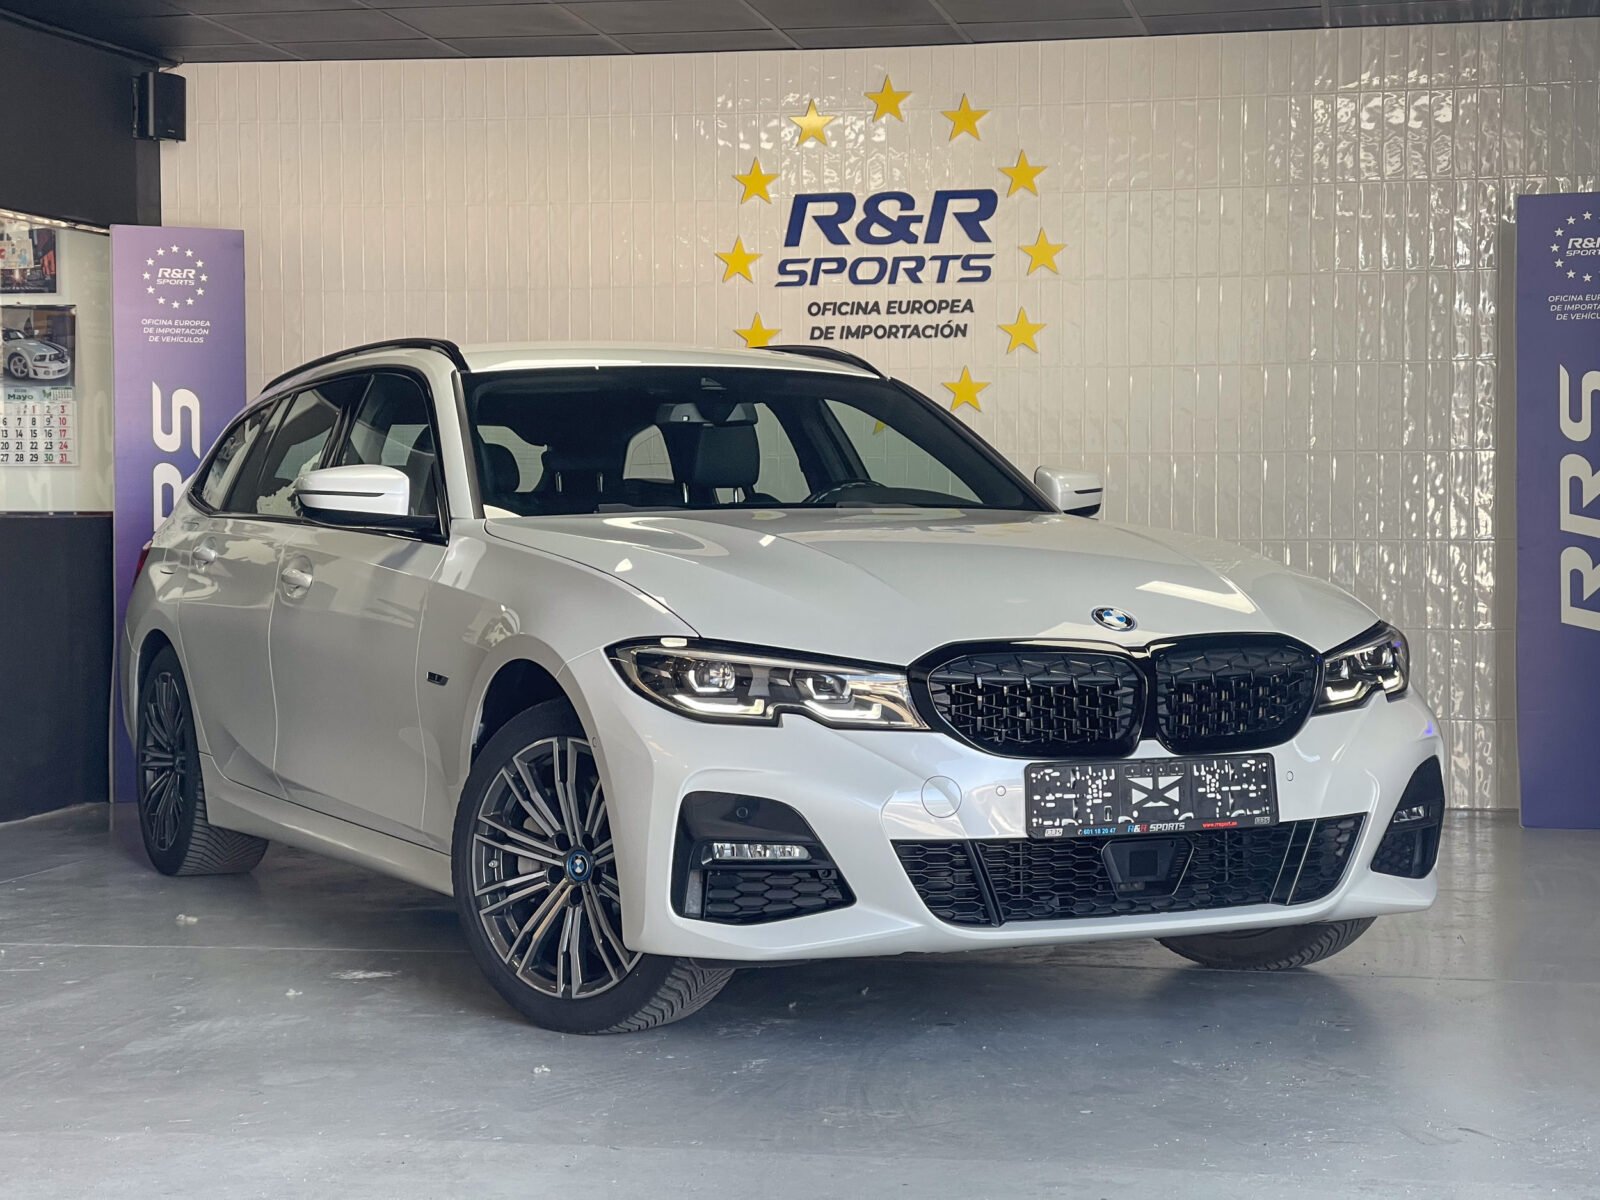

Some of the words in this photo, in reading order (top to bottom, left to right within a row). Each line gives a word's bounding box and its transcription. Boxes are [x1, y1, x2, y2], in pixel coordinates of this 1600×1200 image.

[784, 189, 998, 247] R&R
[158, 268, 196, 279] R&R
[775, 254, 996, 288] SPORTS
[1548, 294, 1583, 302] OFICINA
[807, 300, 882, 317] OFICINA
[886, 298, 974, 316] EUROPEA
[810, 326, 834, 340] DE
[840, 320, 968, 340] IMPORTACIÓN
[46, 405, 50, 413] 2
[61, 405, 65, 413] 3
[1, 430, 8, 438] 13
[16, 430, 23, 438] 14
[31, 430, 37, 438] 15
[44, 430, 52, 438] 16
[59, 430, 66, 438] 17
[1, 442, 9, 450] 20
[16, 442, 22, 450] 21
[30, 442, 38, 450] 22
[45, 442, 53, 450] 23
[59, 442, 68, 450] 24
[1128, 824, 1148, 832] R&R
[1150, 822, 1185, 832] SPORTS
